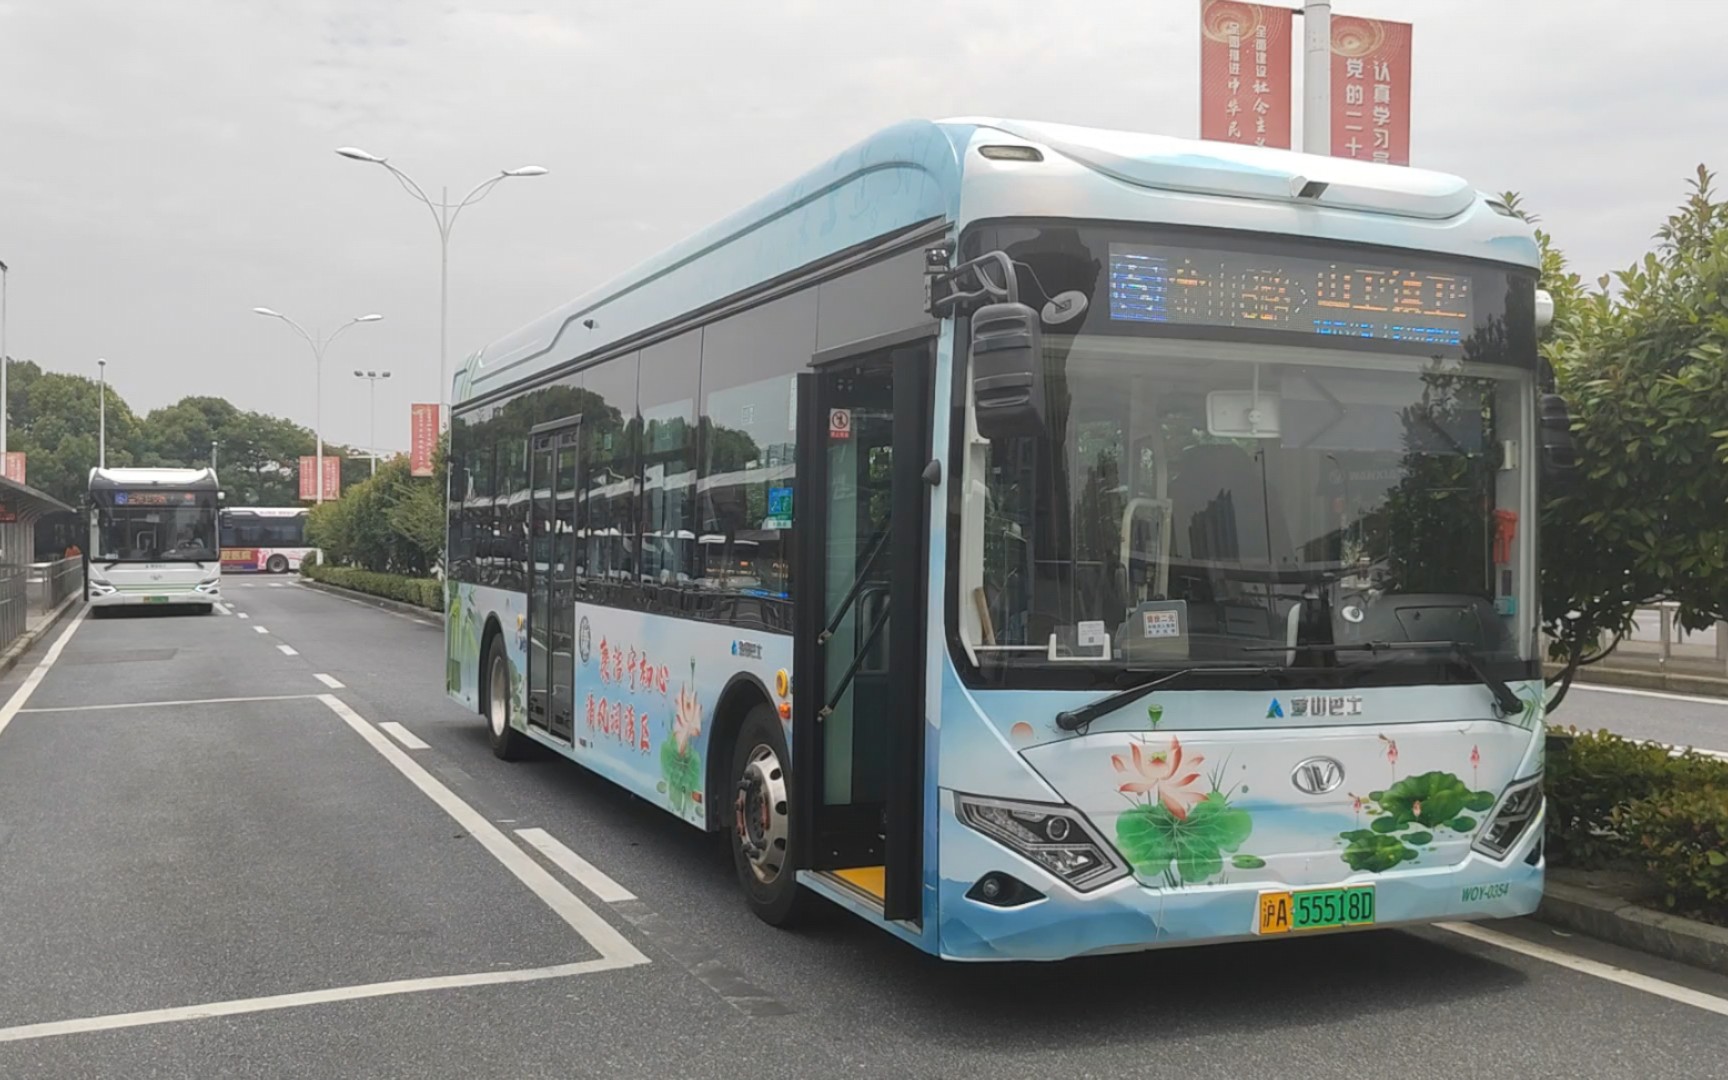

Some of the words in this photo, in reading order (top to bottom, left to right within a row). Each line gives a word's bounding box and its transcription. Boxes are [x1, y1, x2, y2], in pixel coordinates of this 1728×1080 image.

[1226, 22, 1242, 145] 全面推进中华民
[1344, 58, 1364, 157] 党的二十
[1298, 891, 1373, 925] 55518D
